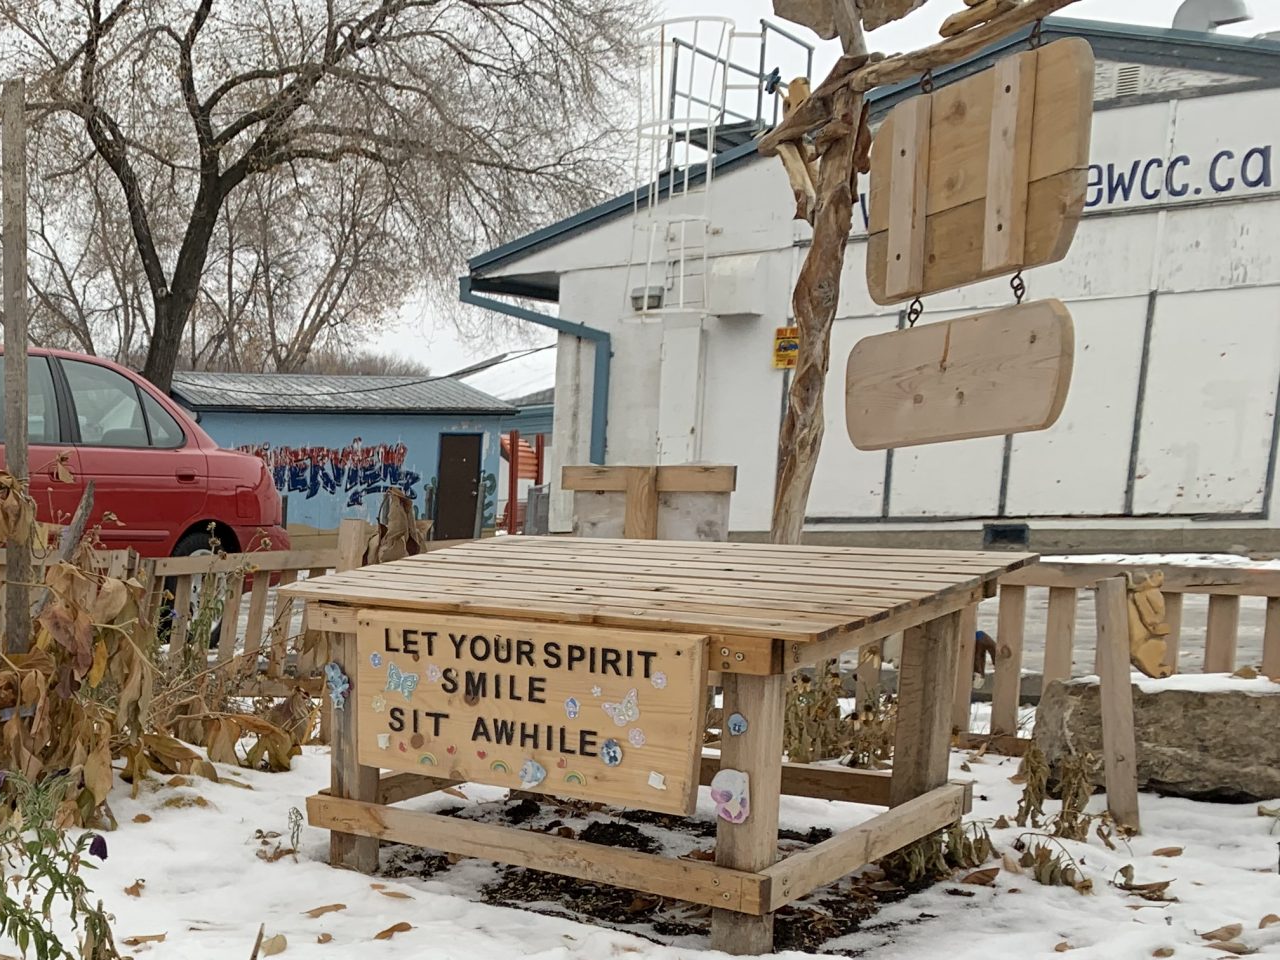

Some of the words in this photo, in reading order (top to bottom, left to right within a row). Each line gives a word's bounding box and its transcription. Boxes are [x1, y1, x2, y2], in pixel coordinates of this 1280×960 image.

[384, 628, 438, 656] LET
[448, 633, 536, 667] YOUR
[543, 641, 658, 679] SPIRIT
[441, 667, 547, 704] SMILE
[388, 707, 450, 736] SIT
[471, 716, 599, 757] AWHILE
